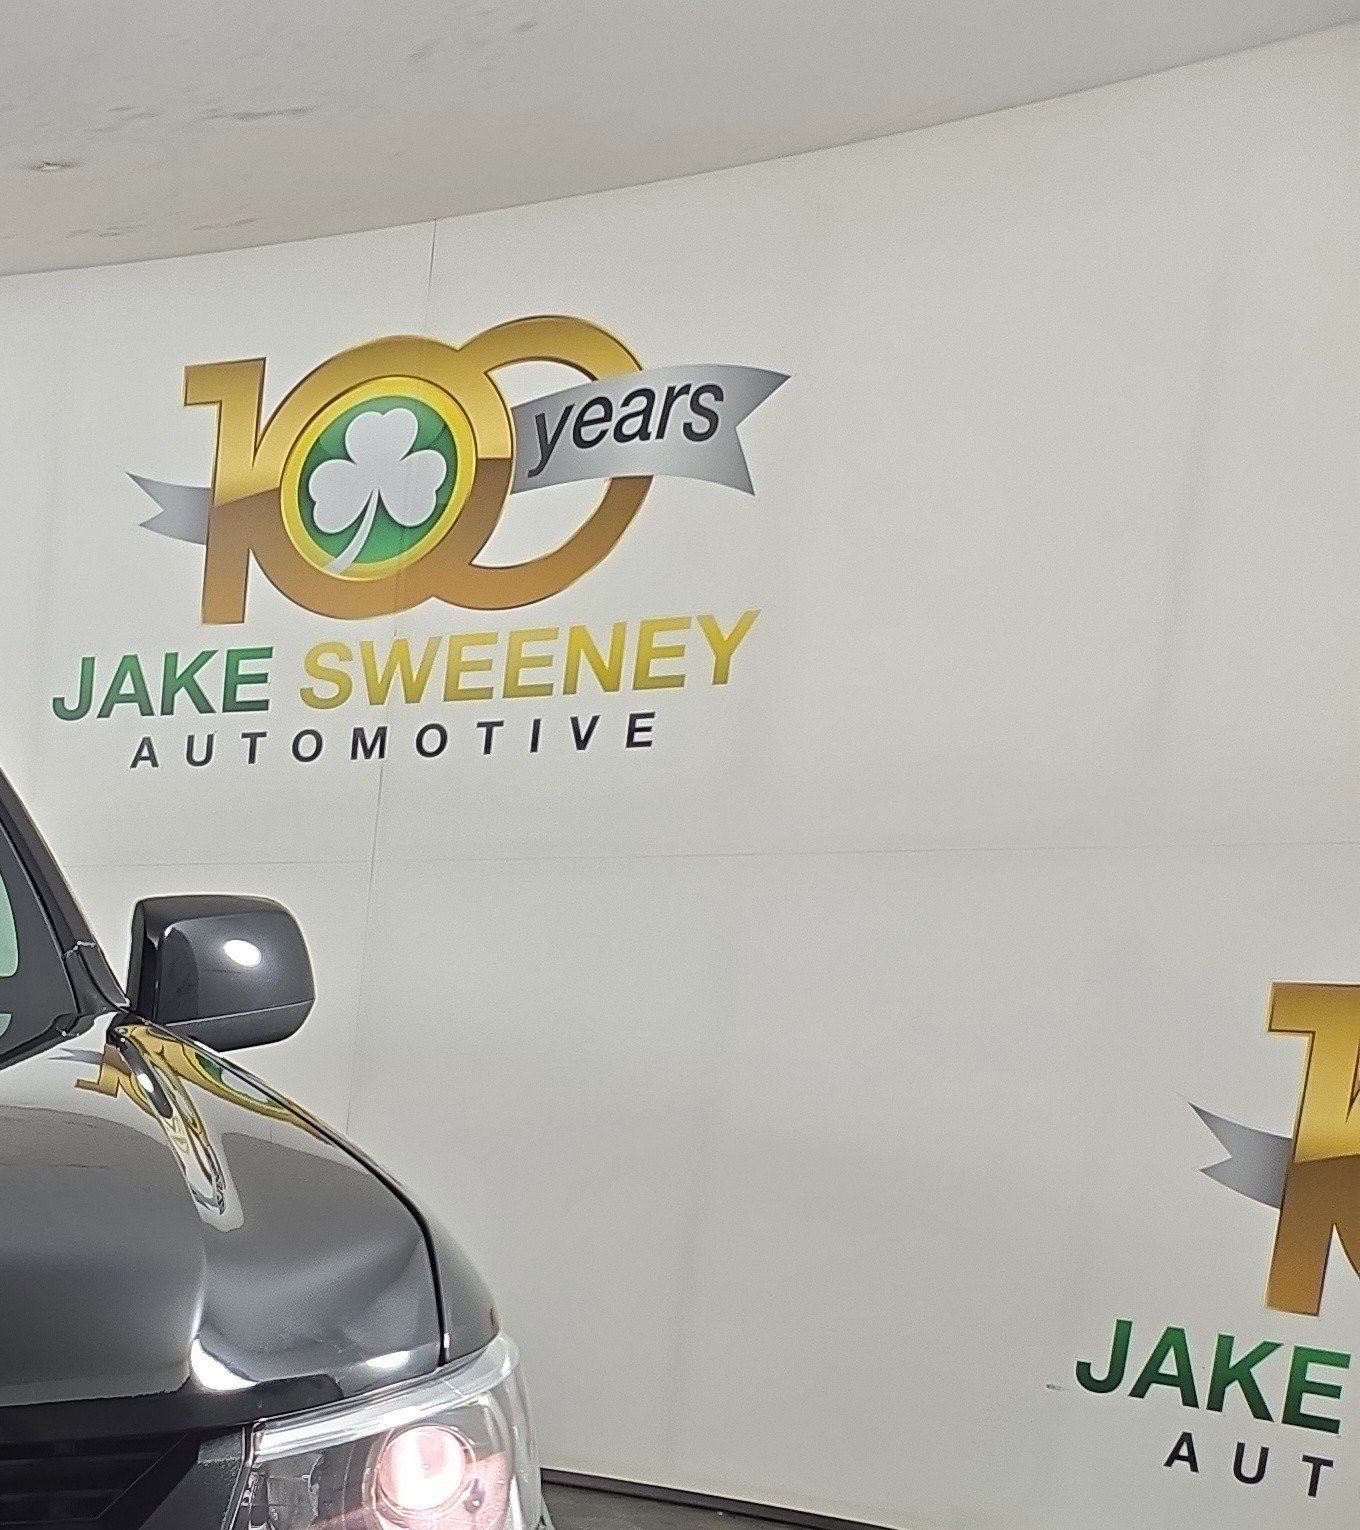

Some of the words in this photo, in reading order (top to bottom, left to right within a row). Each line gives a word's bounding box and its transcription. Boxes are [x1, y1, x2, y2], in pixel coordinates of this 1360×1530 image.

[183, 315, 654, 624] 100
[526, 380, 724, 477] years
[52, 645, 274, 722] JAKE
[299, 609, 761, 711] SWEENEY
[130, 711, 656, 770] AUTOMOTIVE
[1075, 1318, 1352, 1435] JAKE
